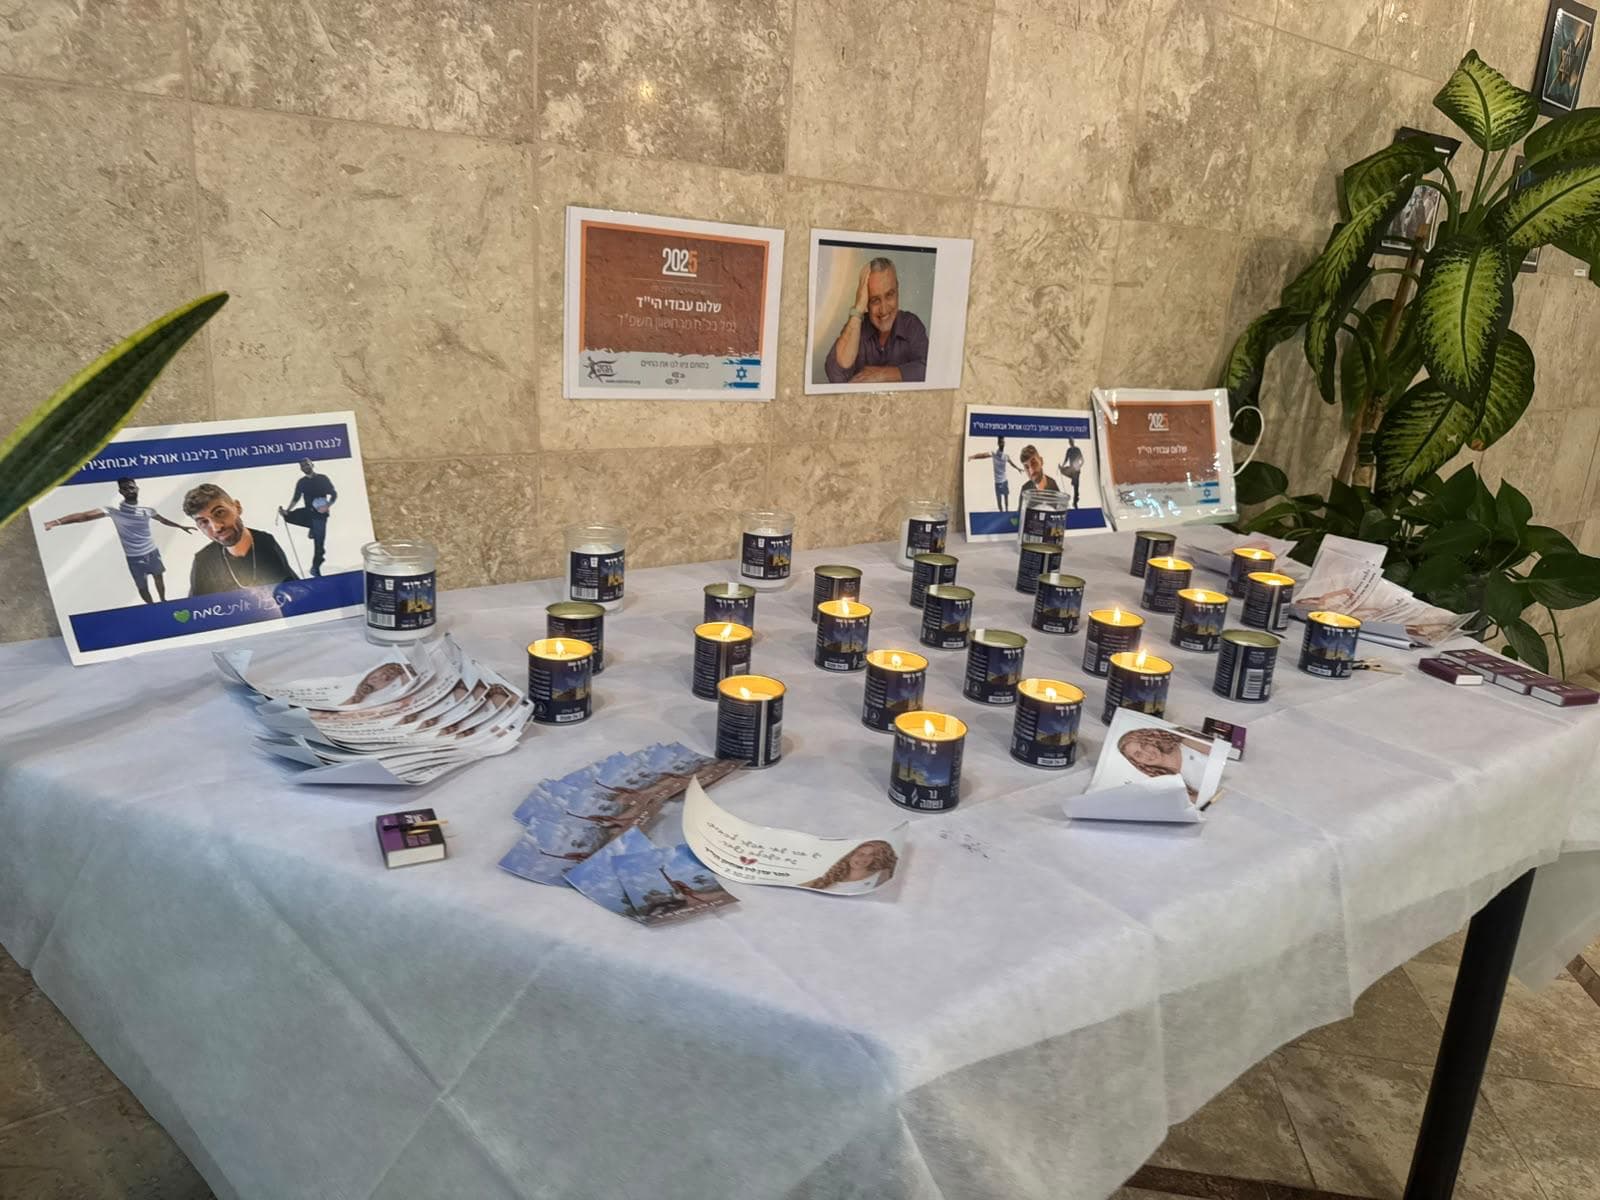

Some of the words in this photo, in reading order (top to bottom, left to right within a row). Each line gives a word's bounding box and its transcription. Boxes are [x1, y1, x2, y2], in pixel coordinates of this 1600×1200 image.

[662, 248, 698, 277] 2025
[664, 298, 693, 311] עבודי
[696, 300, 722, 312] שלום
[286, 441, 313, 450] נזכור
[314, 437, 342, 449] לנצח
[181, 448, 218, 462] בליבנו
[220, 446, 249, 460] אותך
[251, 444, 284, 456] ונאהב
[140, 452, 179, 466] אוראל
[193, 604, 224, 620] שמח
